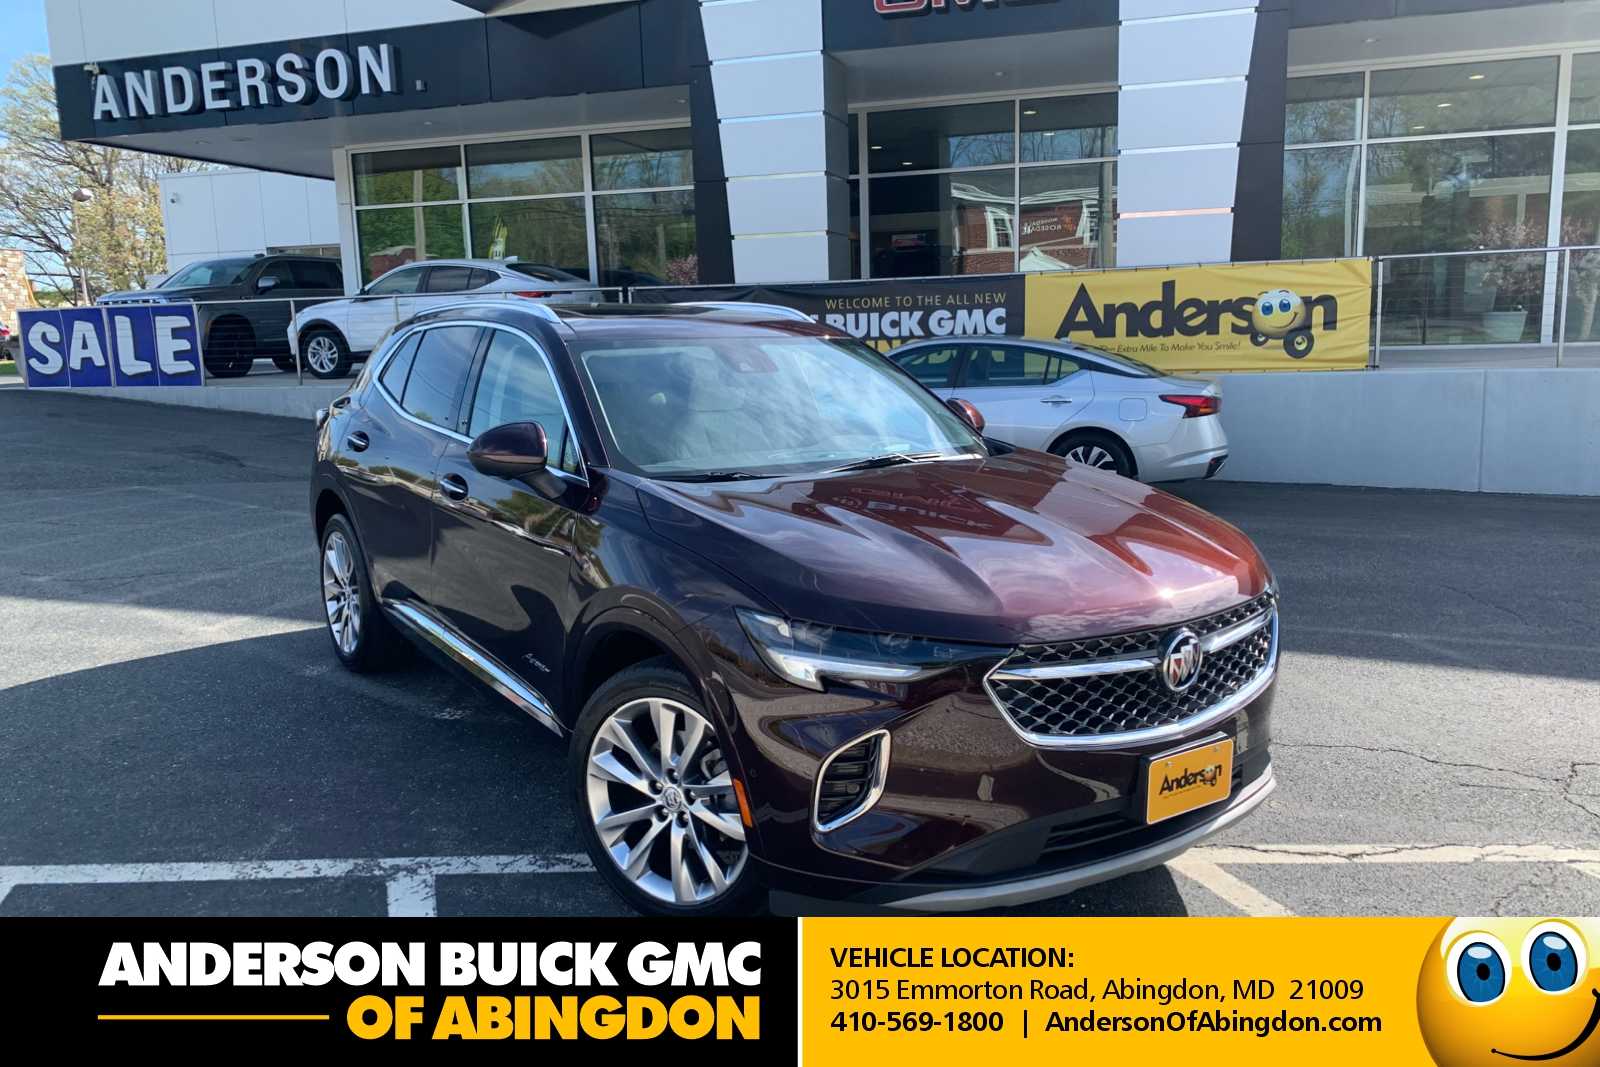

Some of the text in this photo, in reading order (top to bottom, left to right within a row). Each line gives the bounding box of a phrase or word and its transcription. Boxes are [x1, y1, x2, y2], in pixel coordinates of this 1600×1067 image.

[93, 43, 394, 120] ANDERSON
[825, 292, 1006, 310] WELCOME TO THE ALL NEW
[825, 307, 1007, 338] BUICK GMC
[28, 315, 196, 375] SALE
[1116, 344, 1138, 353] Extra
[1140, 343, 1158, 352] Mile
[1160, 343, 1169, 352] To
[1171, 342, 1196, 352] Make
[1197, 341, 1213, 351] You
